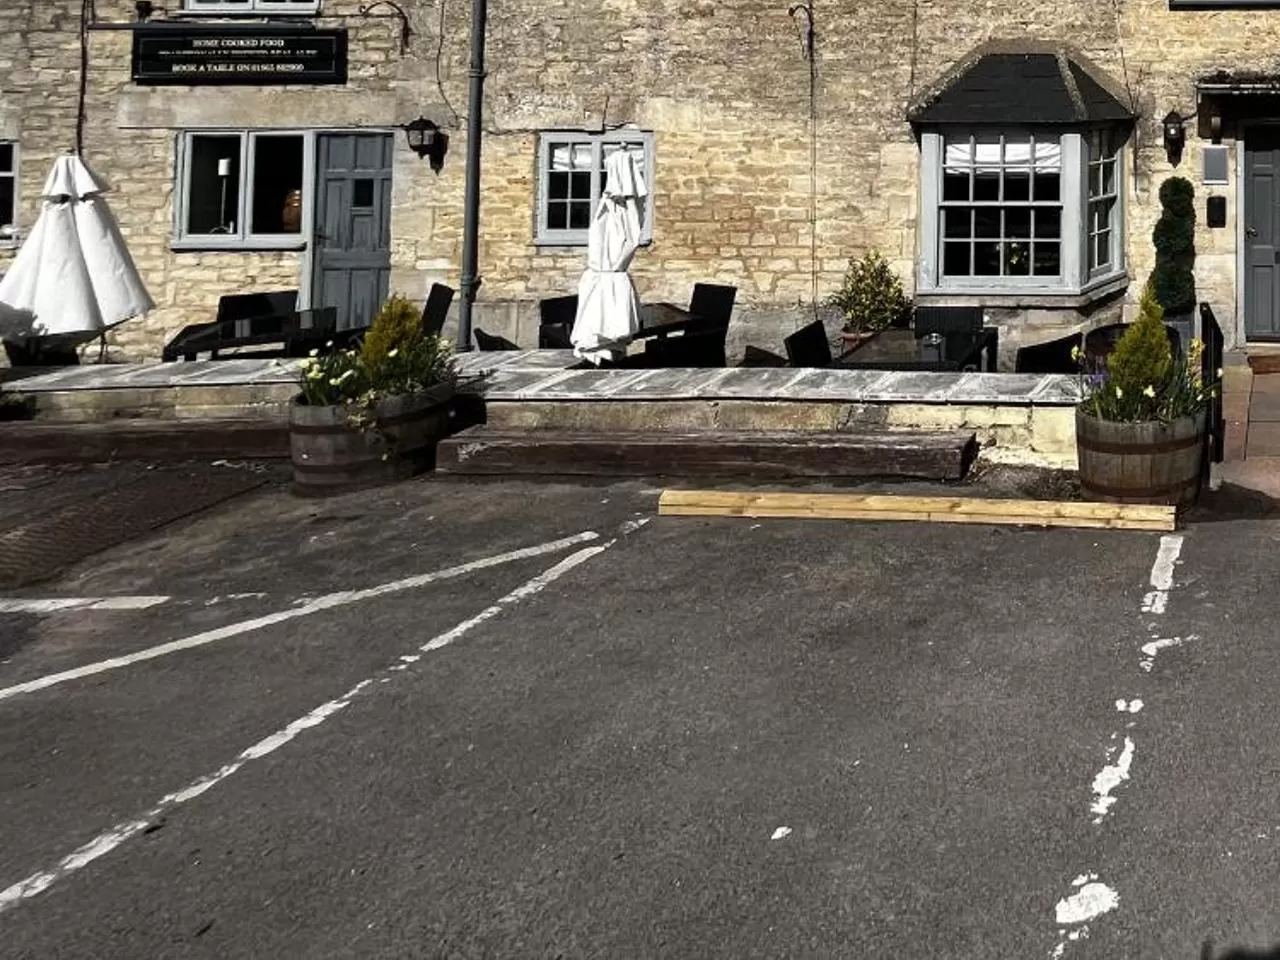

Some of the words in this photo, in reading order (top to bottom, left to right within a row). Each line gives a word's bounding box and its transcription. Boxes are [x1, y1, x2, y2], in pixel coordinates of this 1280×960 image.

[192, 39, 219, 48] HOME
[221, 39, 258, 48] COOKED
[260, 39, 284, 48] FOOD
[172, 63, 197, 72] BOOK
[199, 64, 206, 72] A
[206, 63, 235, 72] TABLE
[236, 63, 250, 72] ON
